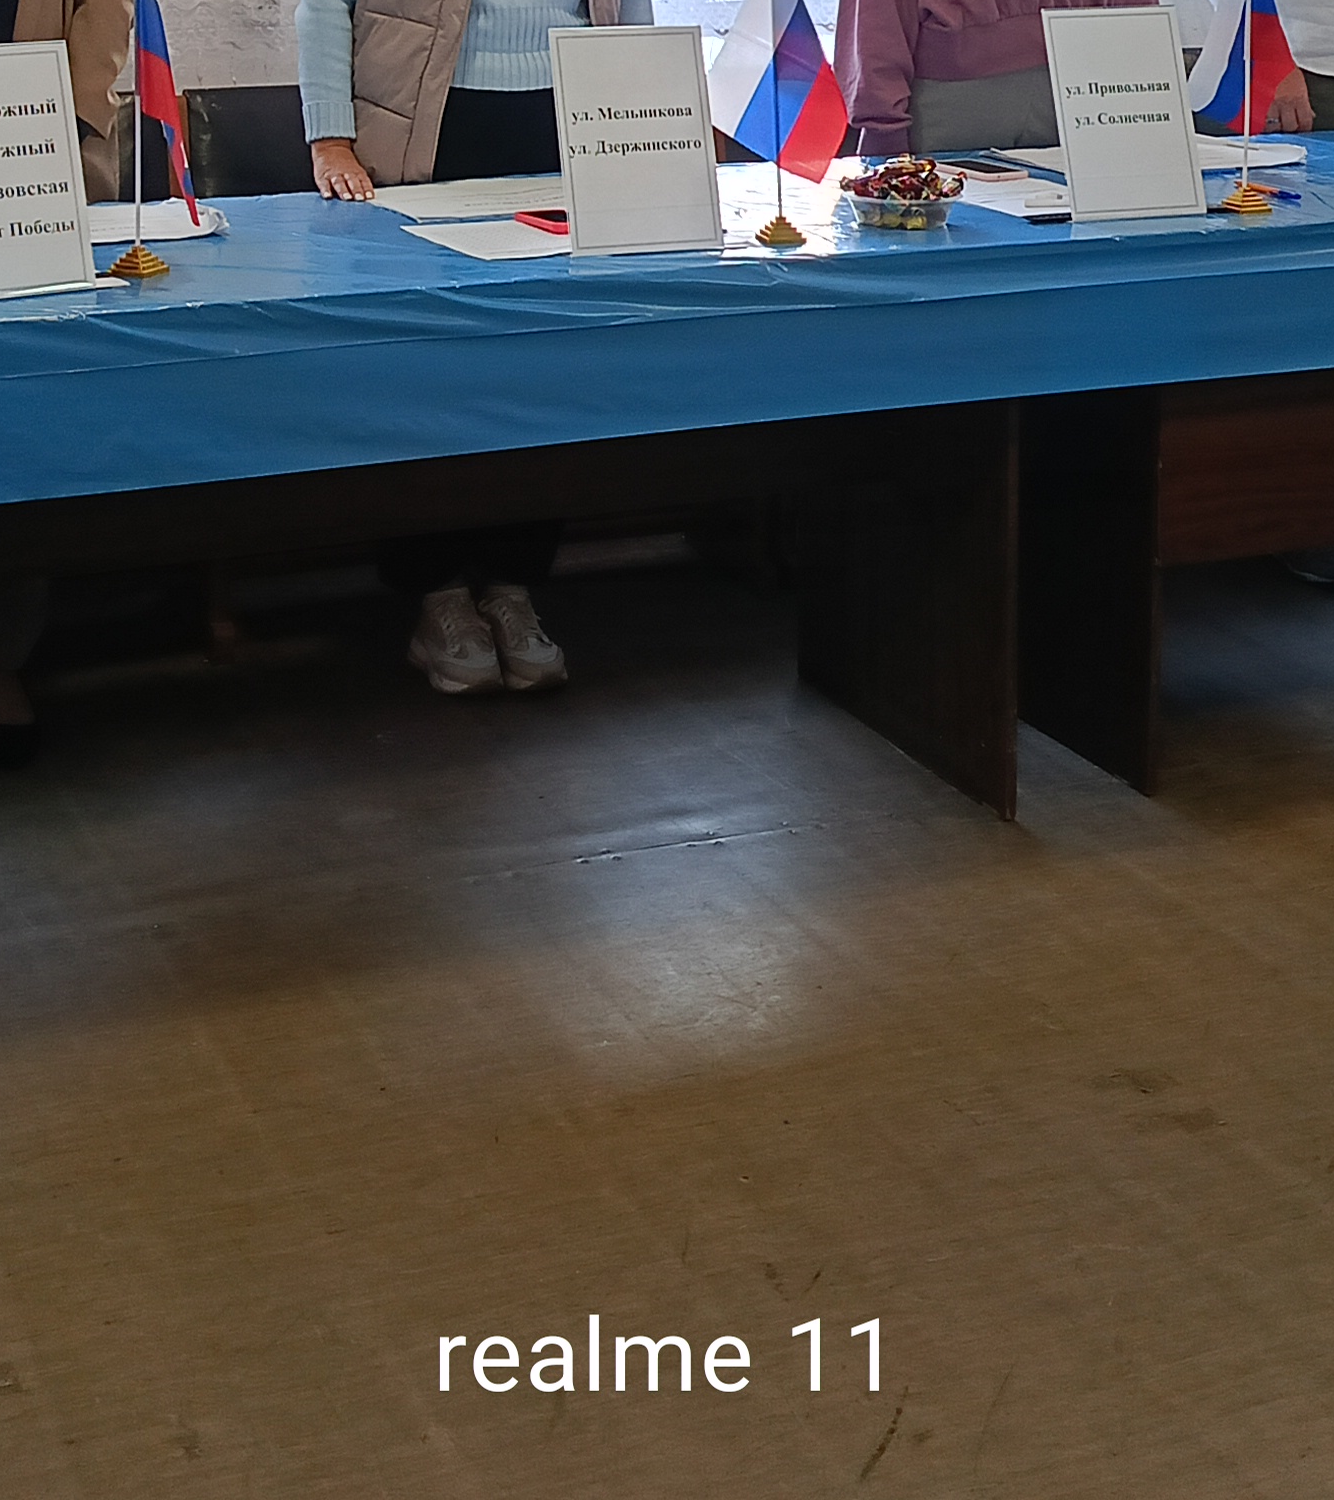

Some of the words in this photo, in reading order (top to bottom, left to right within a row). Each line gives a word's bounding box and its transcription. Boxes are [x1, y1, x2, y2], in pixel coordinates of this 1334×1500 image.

[1065, 85, 1085, 98] ул.
[1088, 81, 1171, 97] Привольная
[572, 110, 593, 125] ул.
[597, 106, 693, 122] Мельникова
[1075, 116, 1095, 129] ул.
[1097, 112, 1170, 125] Солнечная
[569, 144, 591, 158] ул.
[595, 139, 702, 156] Дзержинского
[9, 220, 75, 238] Победы
